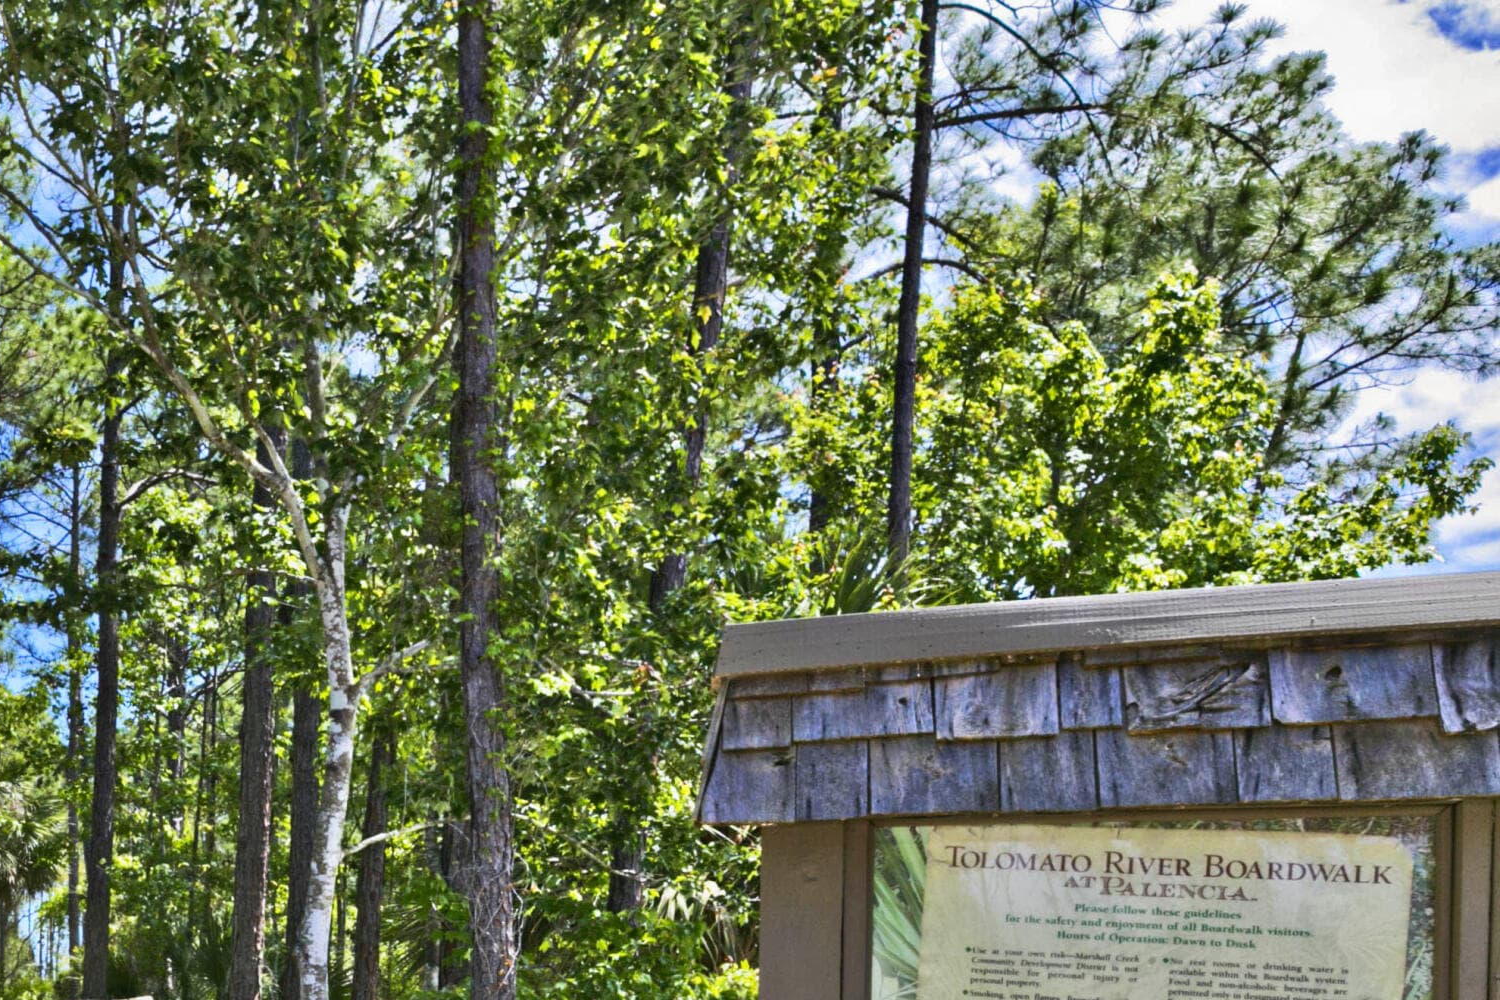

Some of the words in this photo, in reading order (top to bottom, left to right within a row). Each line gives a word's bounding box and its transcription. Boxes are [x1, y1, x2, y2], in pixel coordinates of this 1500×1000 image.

[945, 846, 1092, 873] TOLOMATO
[1104, 851, 1191, 877] RIVER
[1204, 854, 1393, 885] BOARDWALK
[1063, 876, 1096, 888] AT
[1074, 903, 1108, 914] Please
[1112, 903, 1146, 915] follow
[1151, 905, 1180, 917] these
[1183, 908, 1242, 920] guidelines
[1005, 914, 1021, 923] for
[1024, 915, 1041, 924] the
[1044, 916, 1077, 928] safety
[1080, 918, 1101, 928] and
[1105, 918, 1163, 932] enjoyment
[1166, 923, 1179, 931] of
[1182, 923, 1197, 932] all
[1200, 924, 1263, 936] Boardwalk
[1057, 930, 1090, 941] Hours
[1094, 932, 1106, 941] of
[1172, 936, 1206, 946] Dawn
[1210, 939, 1222, 947] to
[1226, 938, 1256, 949] Dusk
